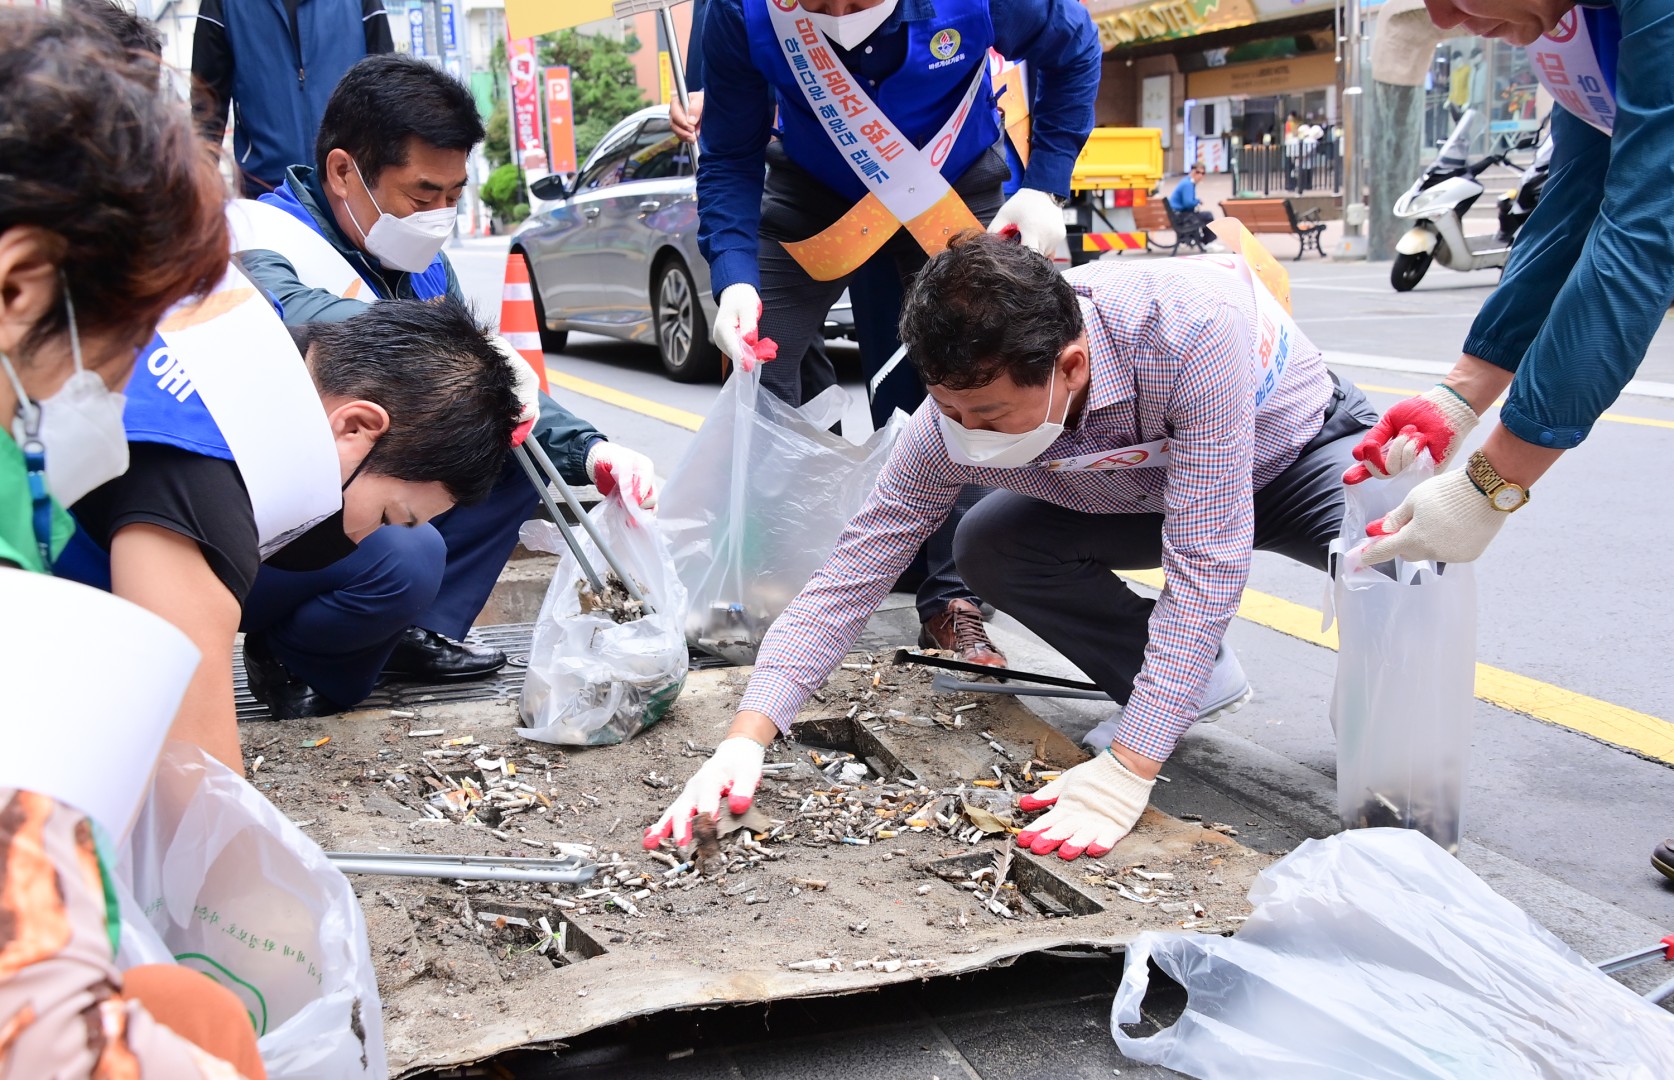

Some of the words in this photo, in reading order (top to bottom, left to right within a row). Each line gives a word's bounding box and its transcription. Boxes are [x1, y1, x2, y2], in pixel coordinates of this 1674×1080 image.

[1134, 0, 1207, 39] HOTEL
[552, 83, 564, 100] P
[784, 37, 825, 101] 아름다운
[818, 105, 857, 147] 해운대
[849, 149, 890, 184] 만들기
[795, 17, 868, 119] 담배꽁초
[860, 119, 904, 162] 없는
